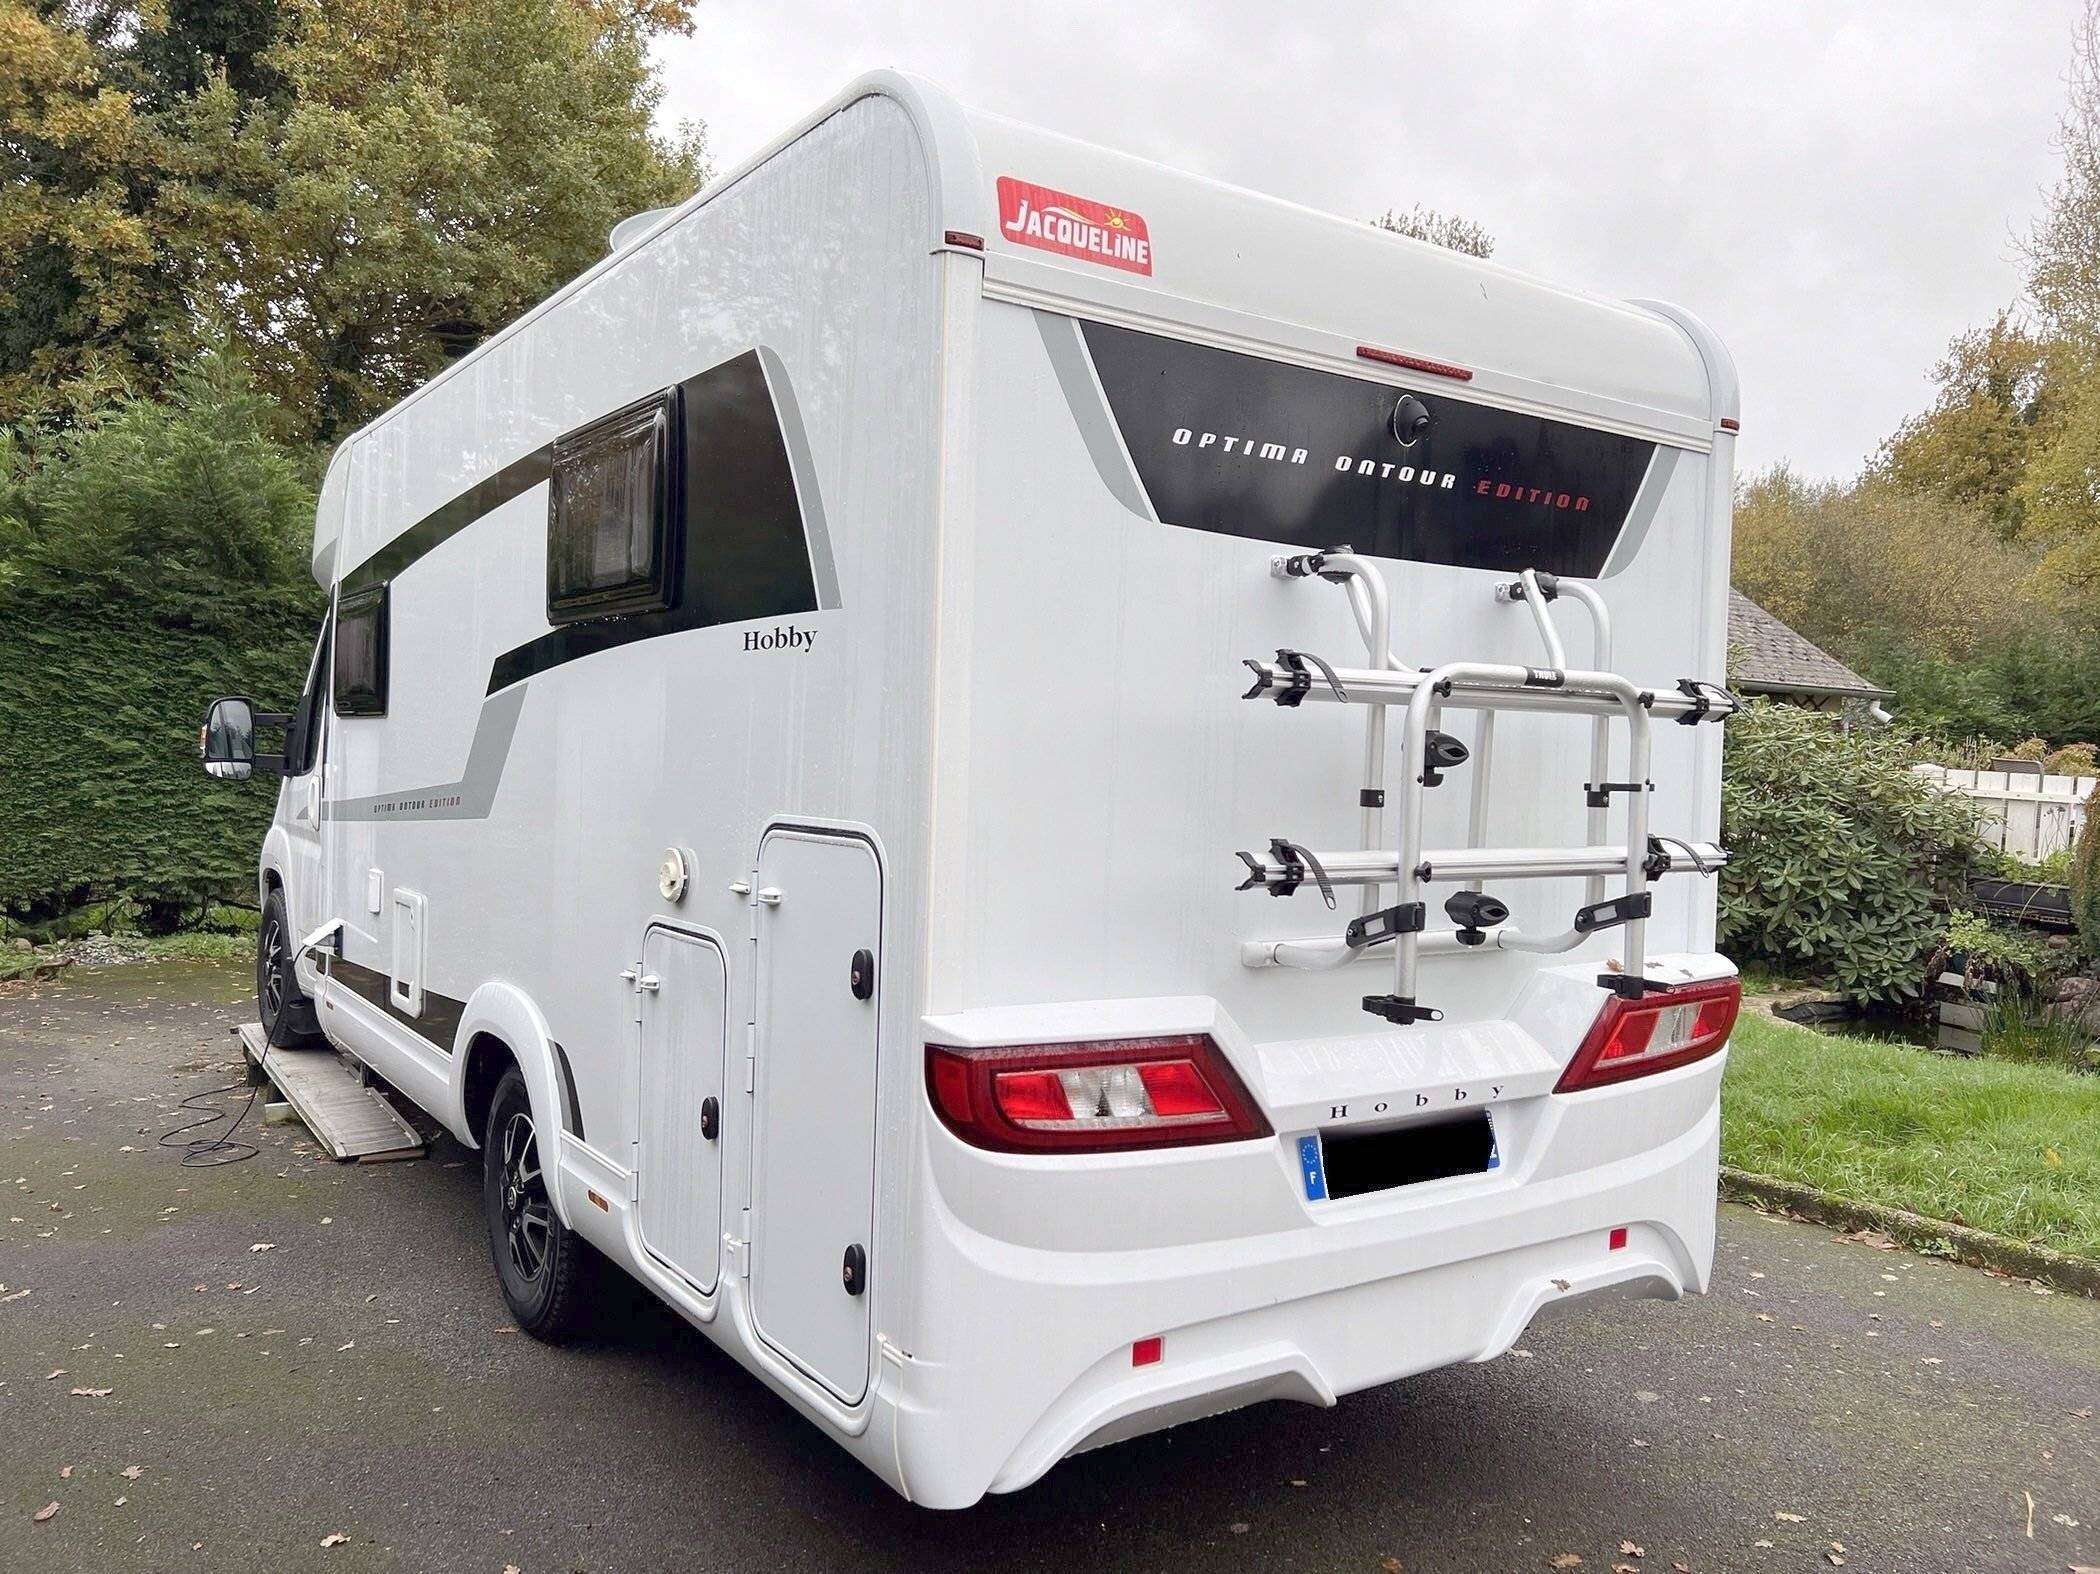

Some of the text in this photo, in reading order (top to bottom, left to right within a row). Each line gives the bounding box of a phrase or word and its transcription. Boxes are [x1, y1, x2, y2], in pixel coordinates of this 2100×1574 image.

[1172, 428, 1591, 512] OPTIMA ONTOUR EDITION
[743, 625, 818, 653] Hobby
[429, 796, 461, 808] EDITION
[1329, 1085, 1504, 1119] Hobby
[1309, 1171, 1317, 1185] F
